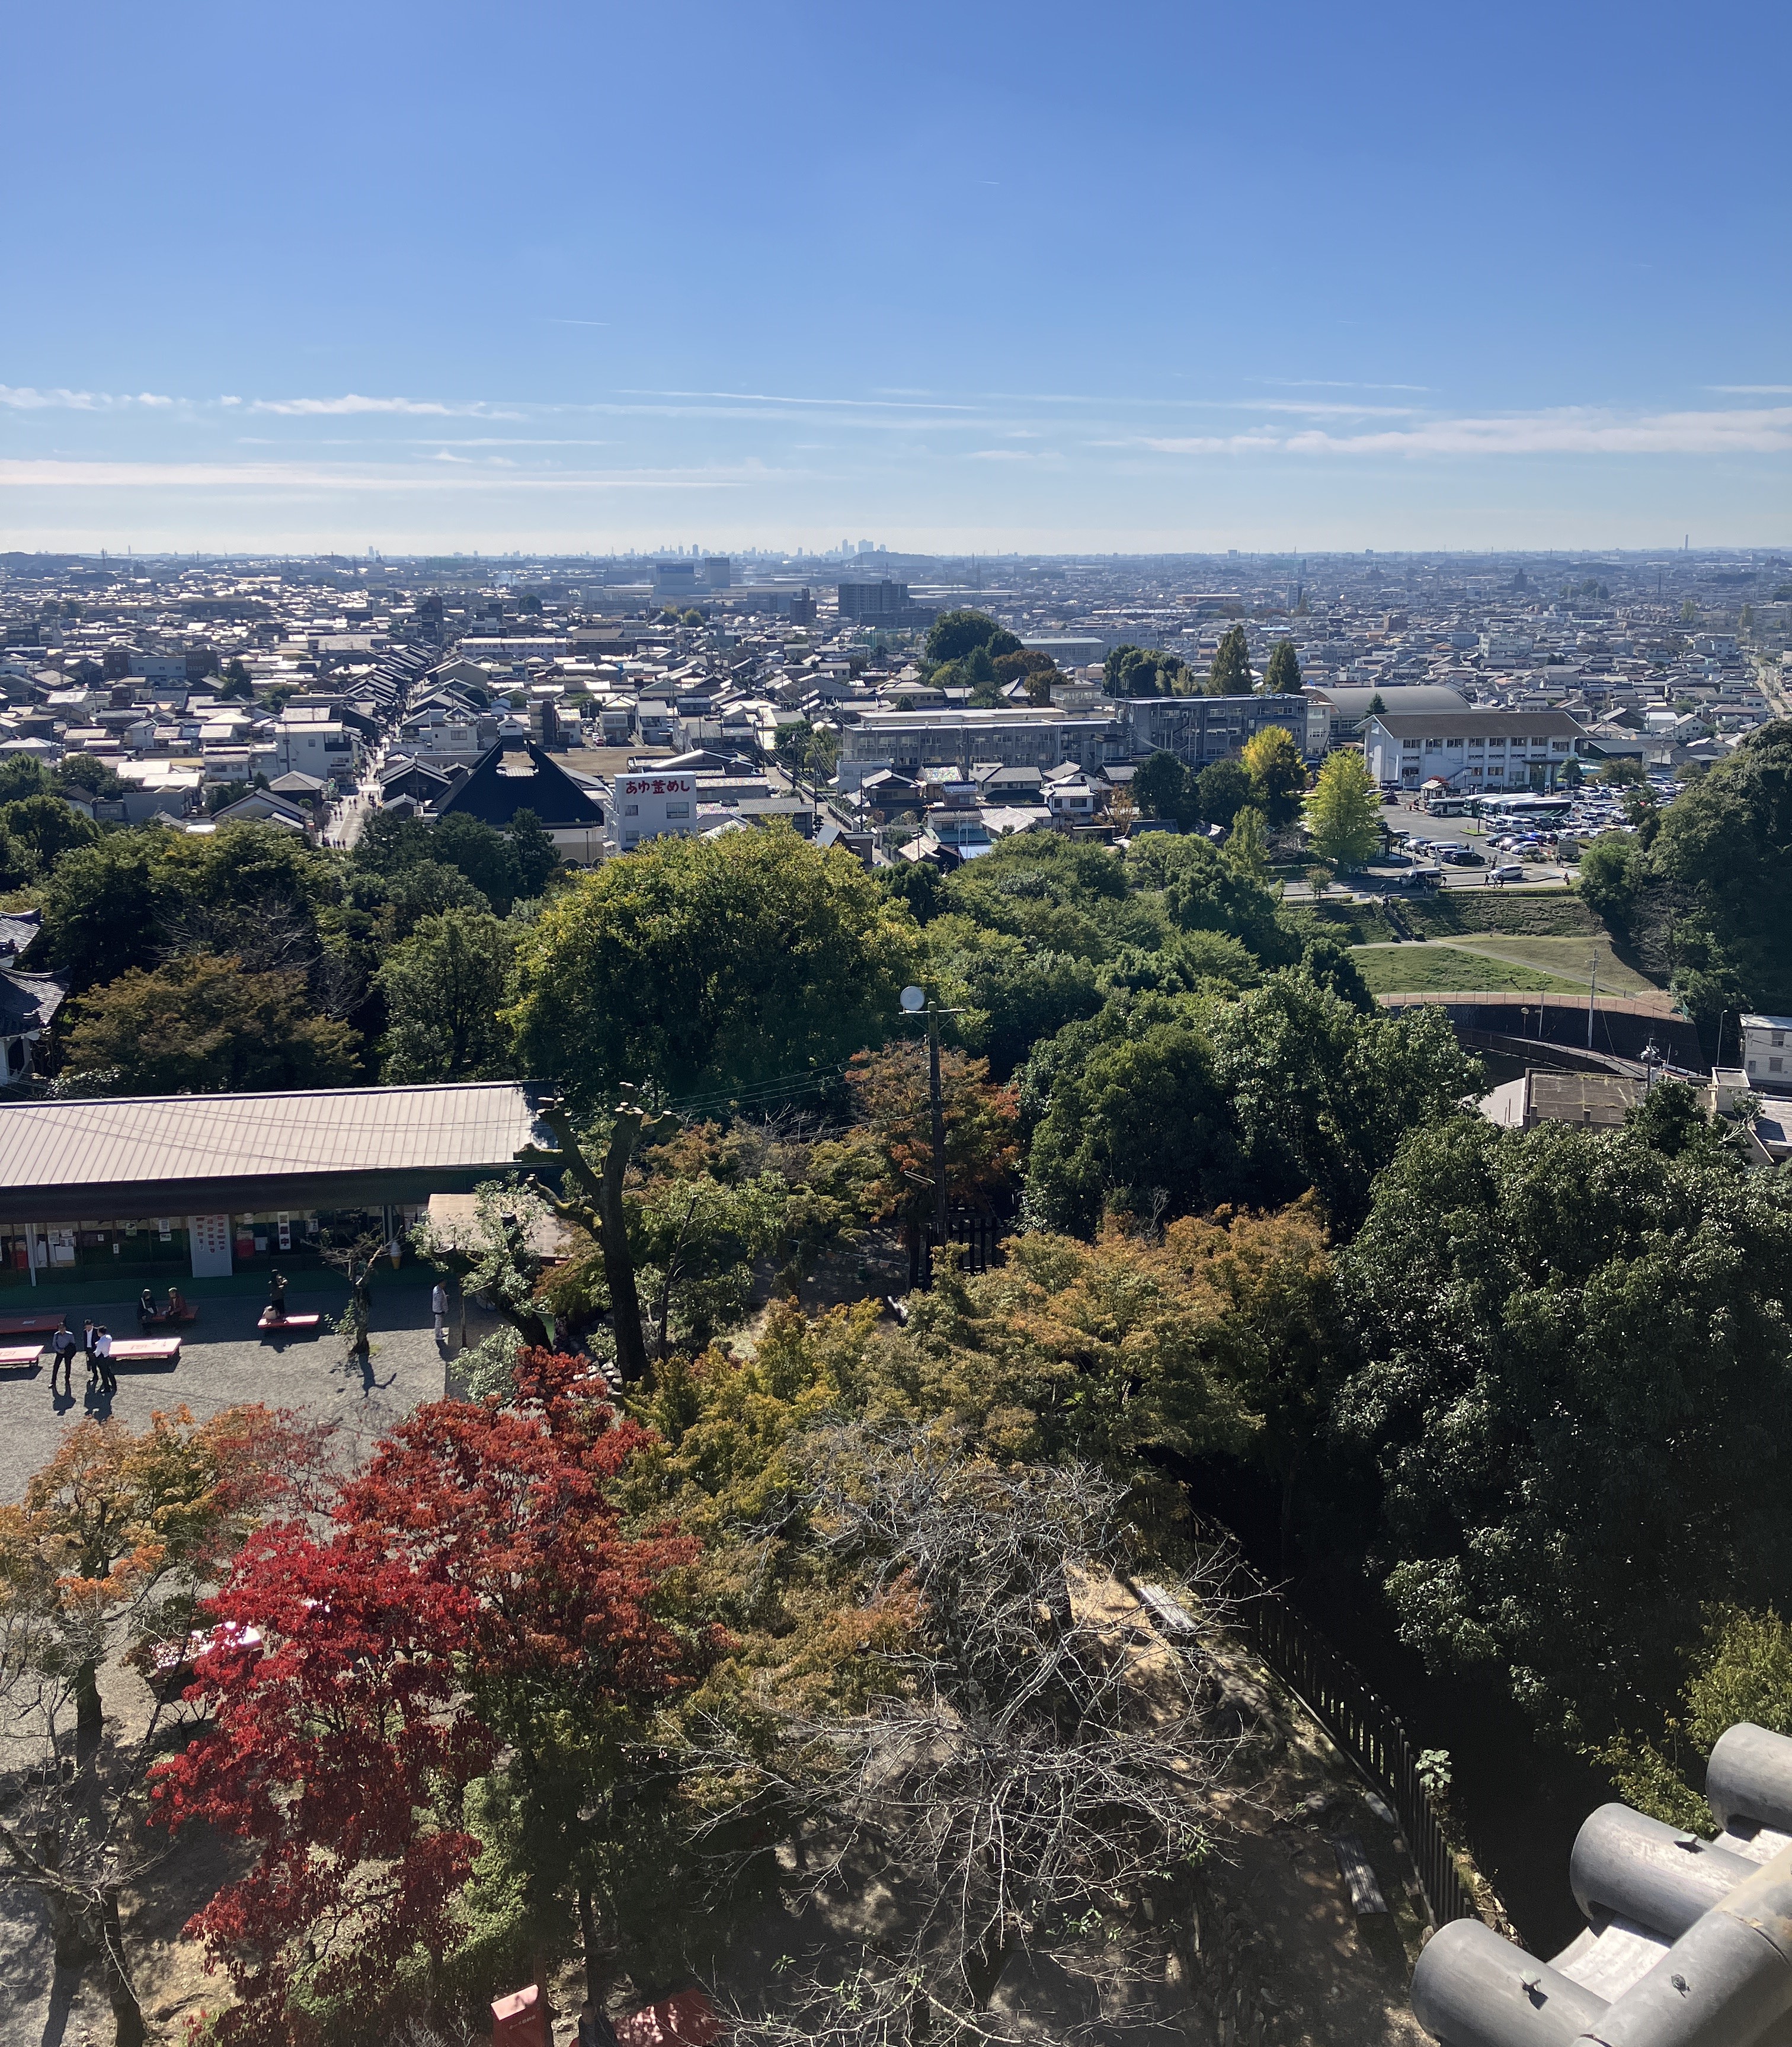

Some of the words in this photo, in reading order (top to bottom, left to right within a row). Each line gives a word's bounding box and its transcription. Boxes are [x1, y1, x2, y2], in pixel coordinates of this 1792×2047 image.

[626, 780, 690, 794] あゆ釜めし
